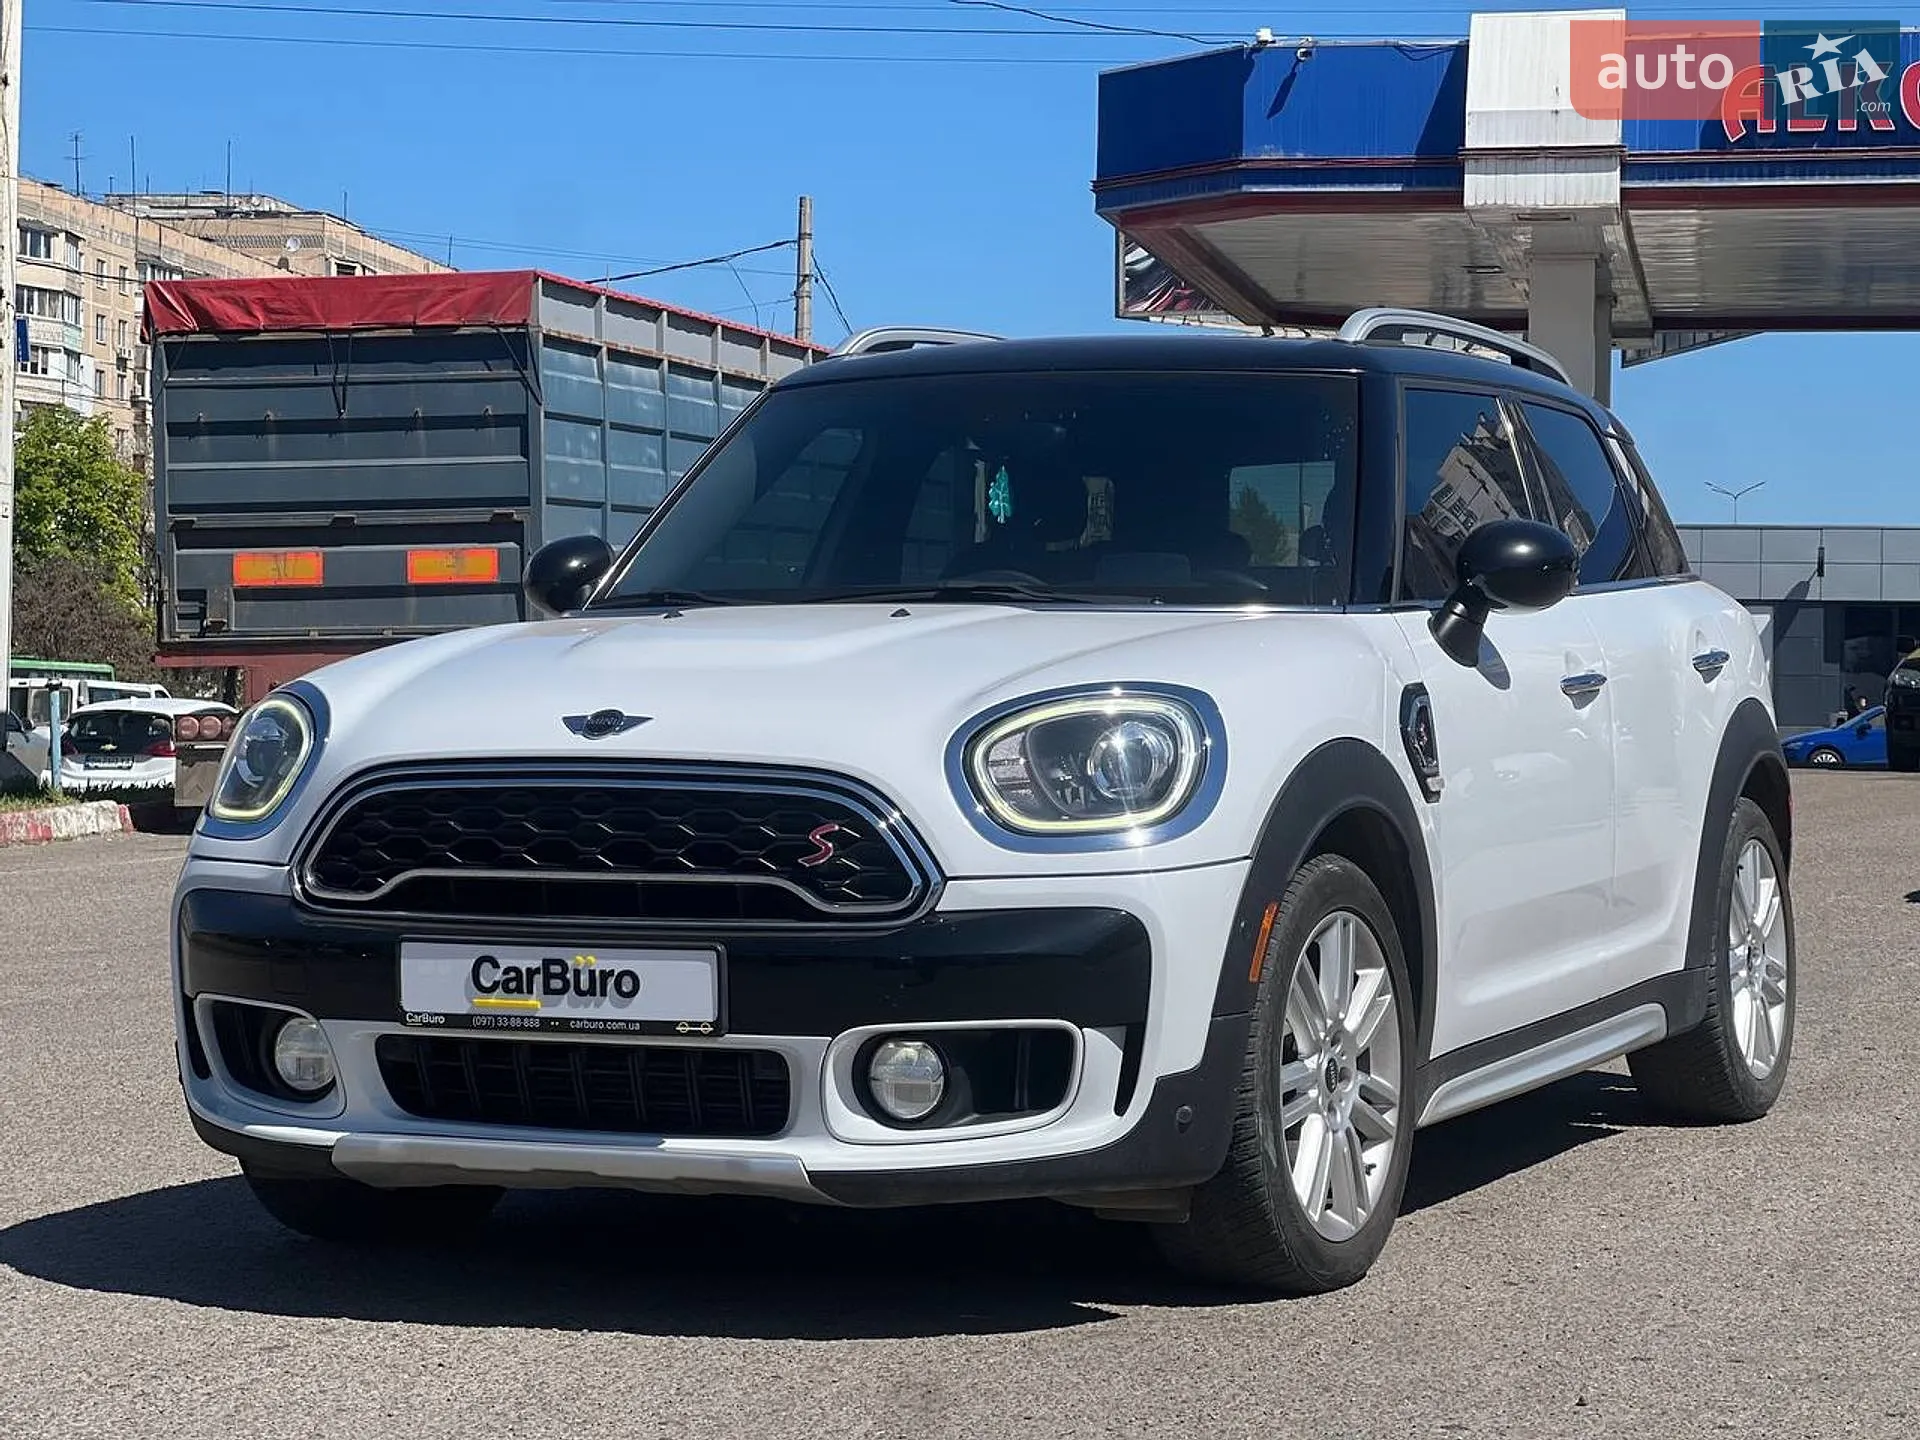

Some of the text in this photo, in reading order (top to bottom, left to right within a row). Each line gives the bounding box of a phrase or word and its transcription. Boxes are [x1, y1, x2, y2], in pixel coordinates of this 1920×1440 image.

[798, 823, 840, 867] S
[472, 955, 641, 999] CarBüro
[472, 1016, 496, 1028] (097)
[569, 1020, 641, 1031] carburo.com.ua
